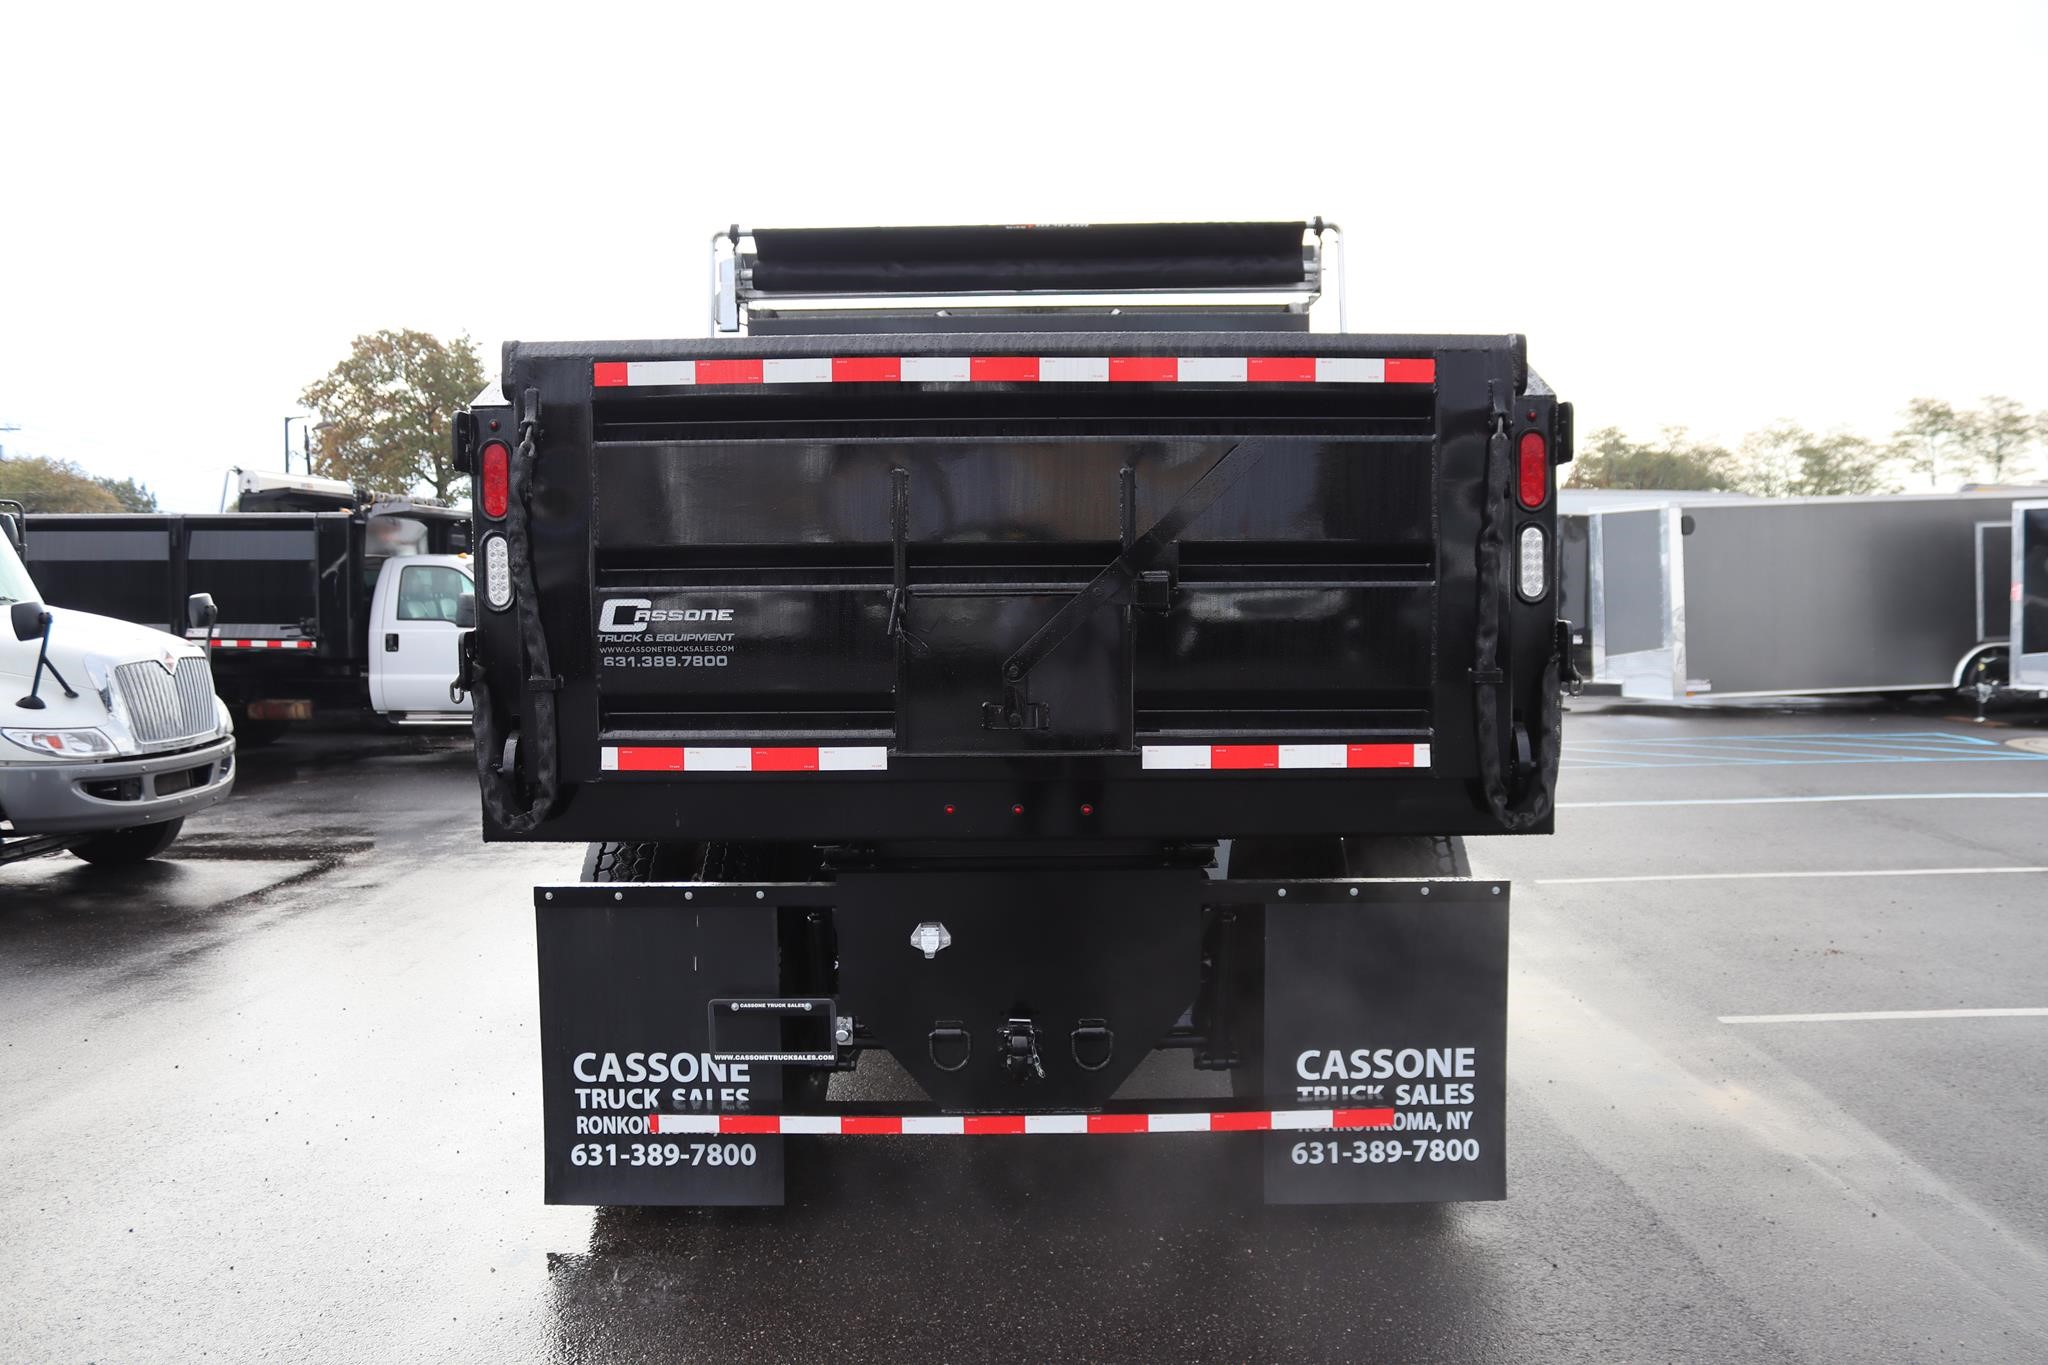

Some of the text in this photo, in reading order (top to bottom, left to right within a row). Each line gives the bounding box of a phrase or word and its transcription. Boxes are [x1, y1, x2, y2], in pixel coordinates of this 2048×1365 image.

[597, 633, 735, 642] TRUCK & EQUIPMENT
[599, 645, 735, 653] WWW.CASSONETRUCKSALES.COM
[603, 655, 728, 667] 631.389.7800
[573, 1052, 751, 1083] CASSONE
[1296, 1047, 1476, 1080] CASSONE
[574, 1088, 661, 1110] TRUCK
[1395, 1083, 1475, 1106] SALES
[1446, 1111, 1474, 1130] NY
[570, 1143, 757, 1167] 631-389-7800
[1291, 1138, 1480, 1165] 631-389-7800
